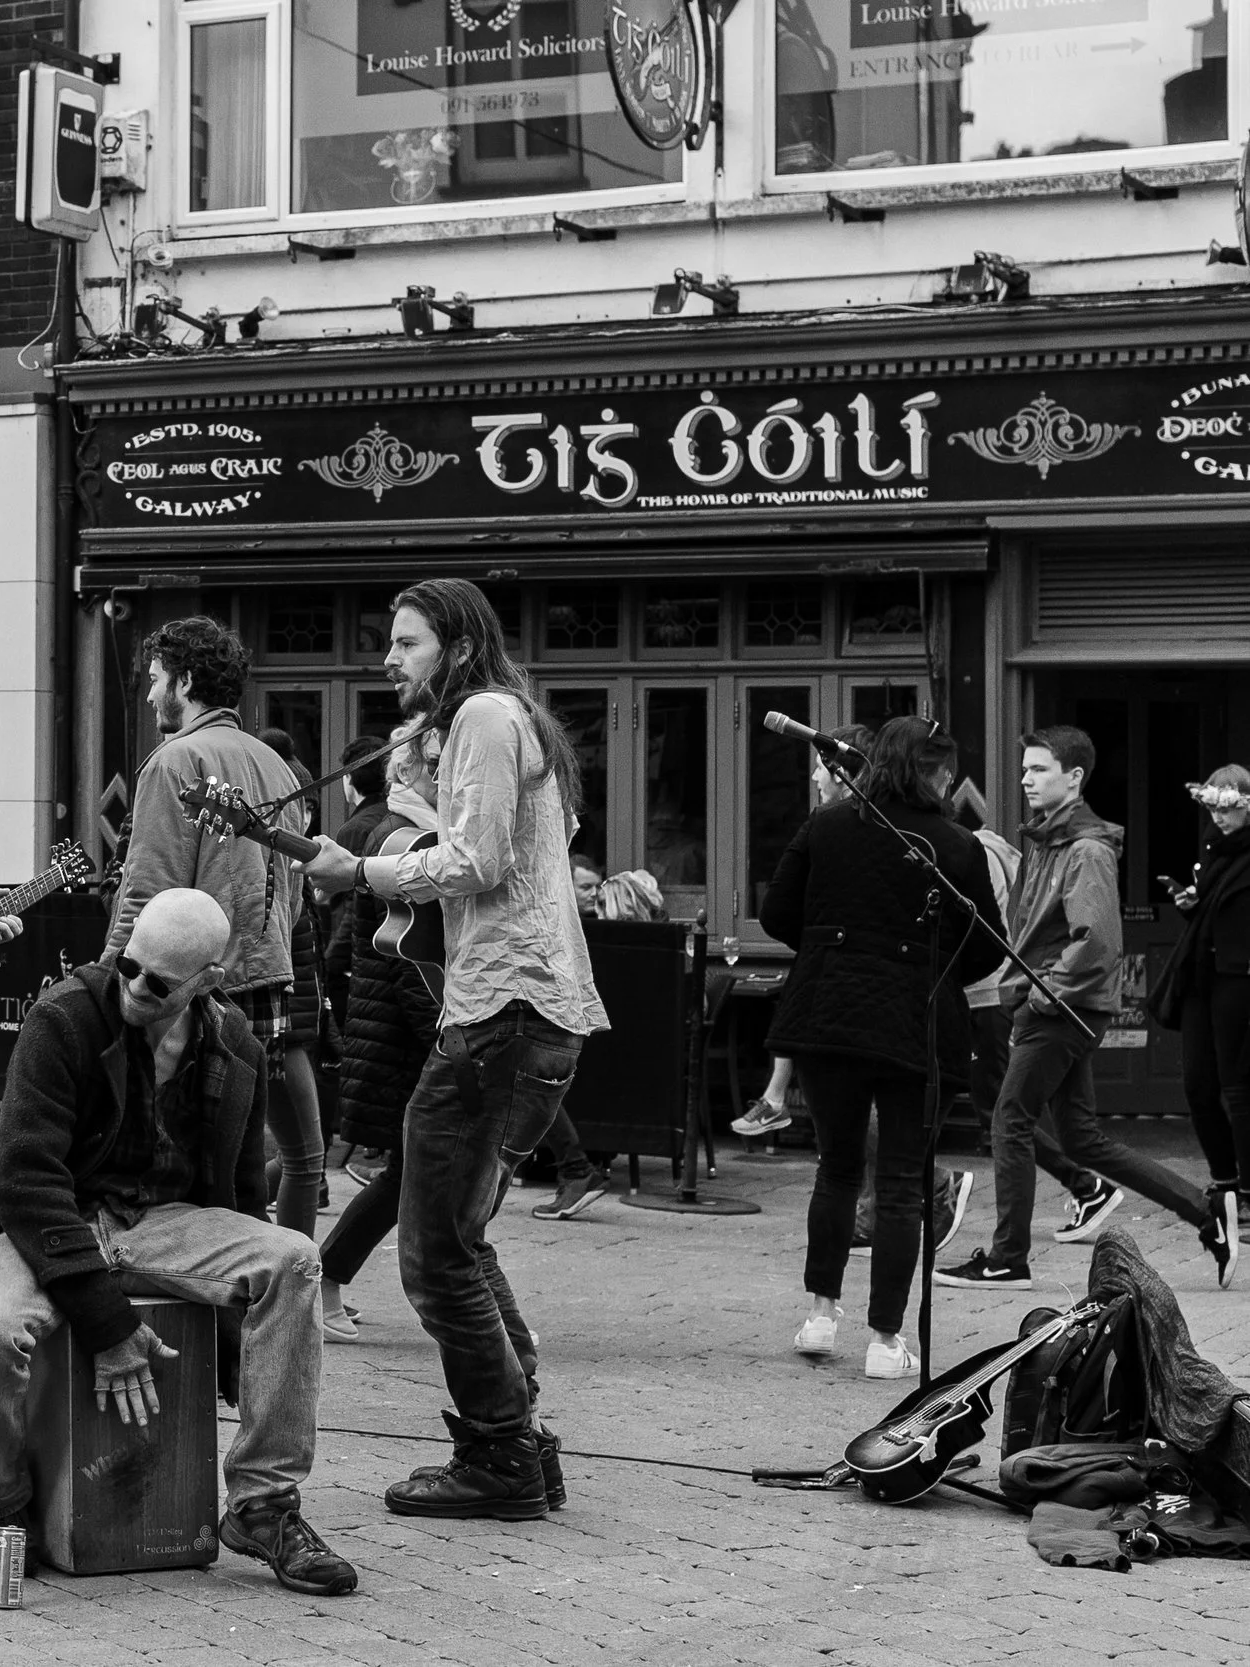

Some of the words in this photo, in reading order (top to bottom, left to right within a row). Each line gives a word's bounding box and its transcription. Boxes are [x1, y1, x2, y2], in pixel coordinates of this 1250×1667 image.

[860, 2, 932, 25] Louise
[366, 50, 429, 74] Louise
[434, 38, 512, 67] Howard
[517, 33, 605, 59] Solicitors
[850, 52, 972, 78] ENTRANCE
[132, 422, 203, 449] ESTD.
[135, 491, 252, 517] GALWAY
[637, 495, 673, 507] THE
[675, 494, 729, 506] HOME
[731, 493, 753, 505] OF
[755, 489, 870, 505] TRADITIONAL
[872, 486, 929, 499] MUSIC
